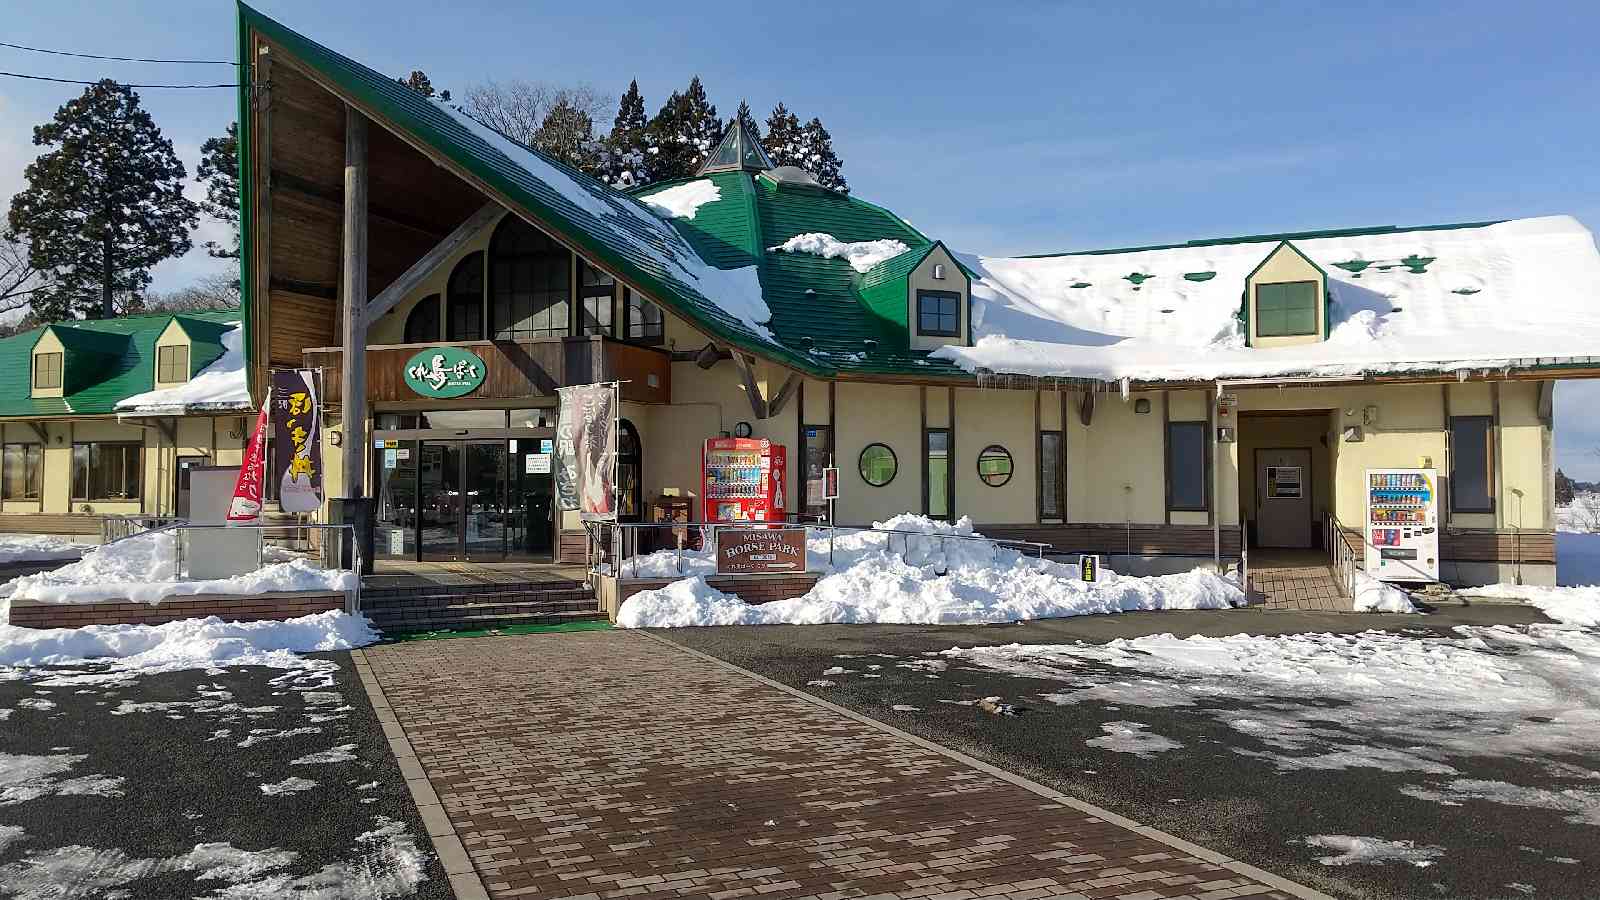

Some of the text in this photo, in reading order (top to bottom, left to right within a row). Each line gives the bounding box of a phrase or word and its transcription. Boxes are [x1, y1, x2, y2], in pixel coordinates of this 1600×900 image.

[743, 532, 783, 542] MISAWA
[726, 542, 800, 558] HORSE PARK
